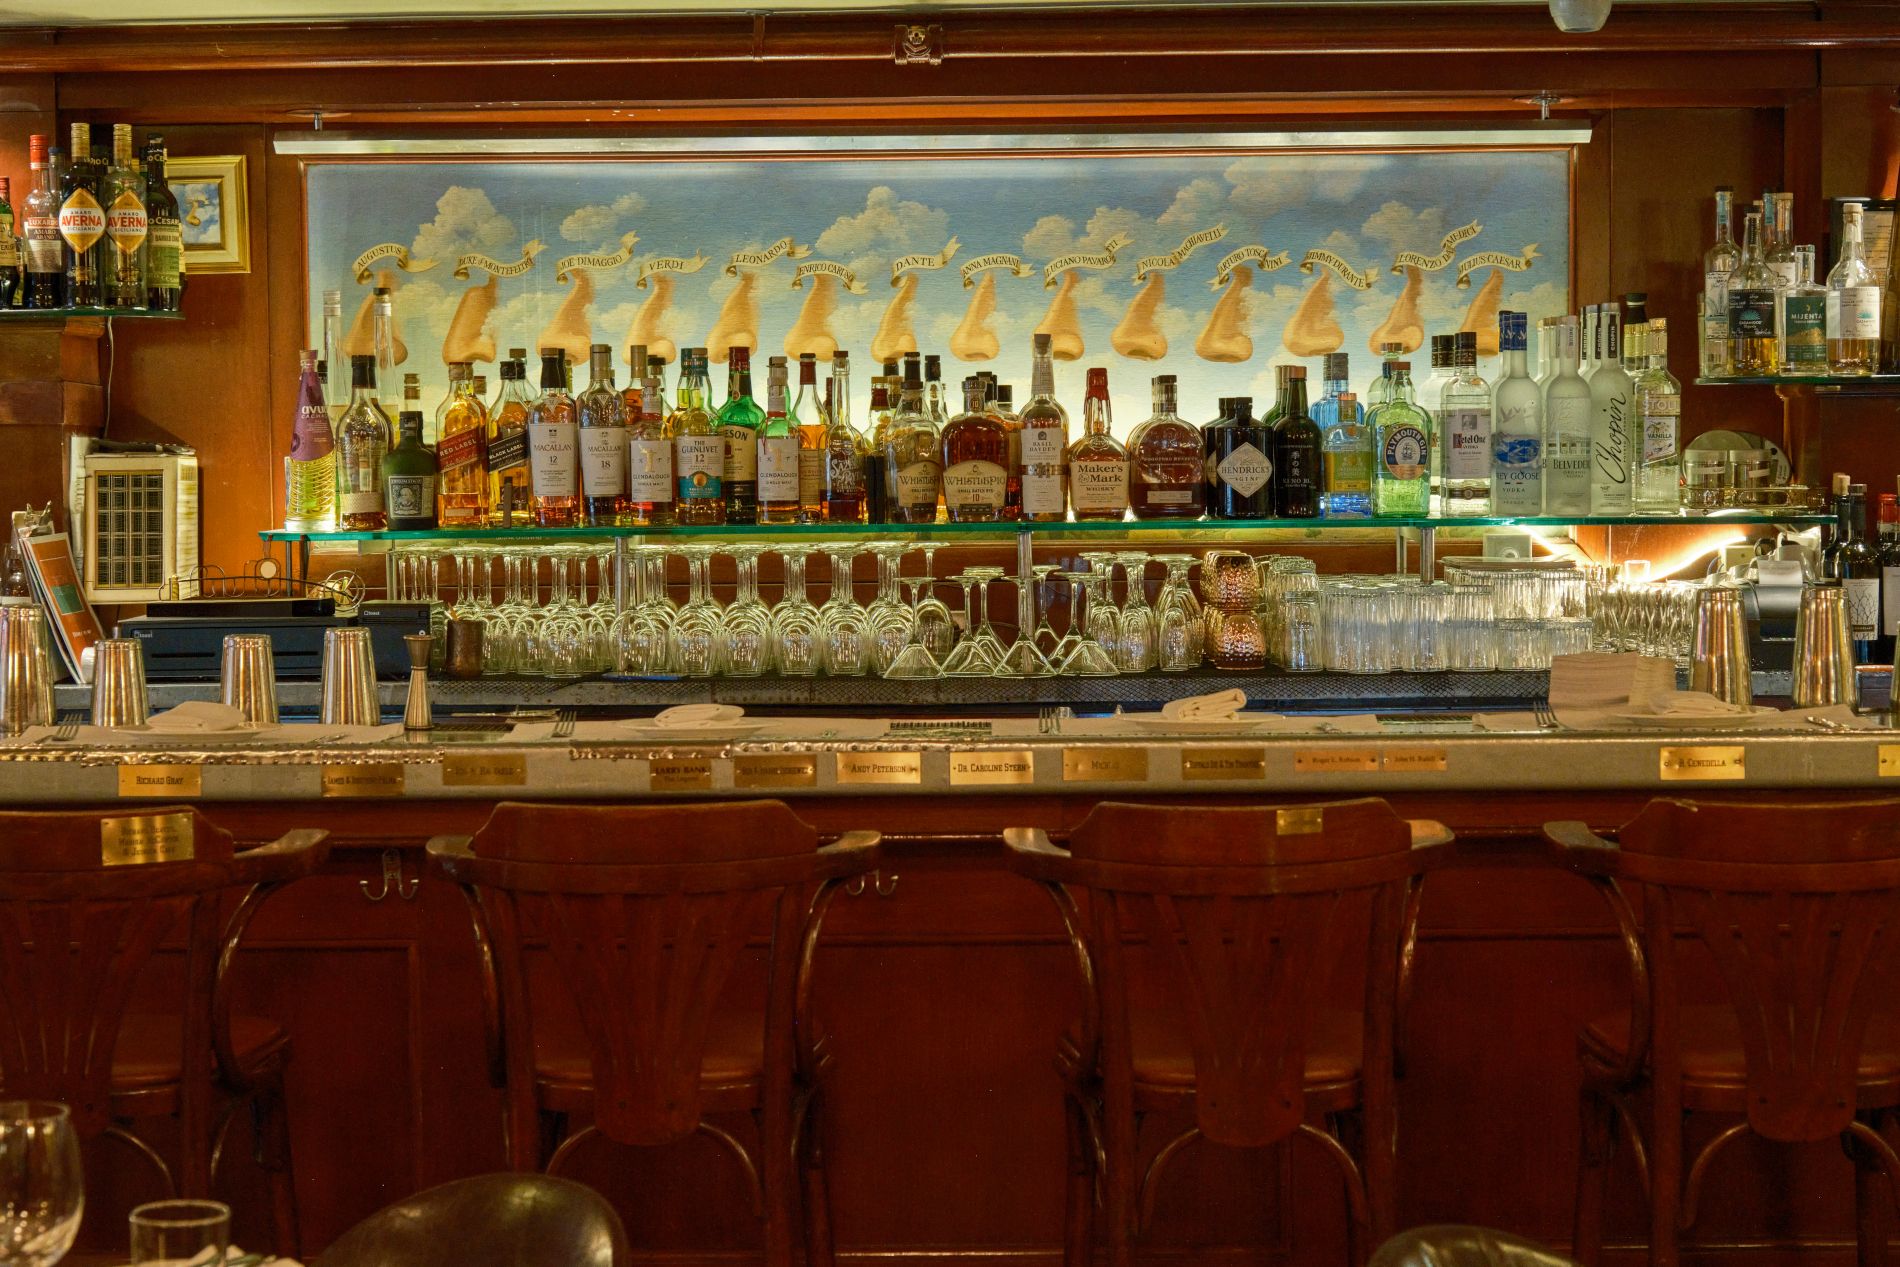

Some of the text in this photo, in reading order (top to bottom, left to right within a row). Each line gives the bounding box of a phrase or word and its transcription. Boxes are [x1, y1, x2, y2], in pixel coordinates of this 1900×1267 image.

[61, 215, 102, 227] AVERNA
[108, 217, 146, 228] AVERNA
[156, 217, 179, 225] CESAR
[735, 240, 788, 264] LEONARDO
[1142, 228, 1222, 270] NICOLA MACHIAVELLI
[1400, 253, 1442, 269] LORENZO
[1446, 226, 1476, 244] MEDICI
[357, 244, 402, 269] AUGUSTUS
[577, 254, 623, 267] DIMAGGIO
[1219, 252, 1245, 273] ARTURO
[1488, 254, 1521, 269] CAESAR
[648, 261, 684, 271] VERDI
[896, 257, 935, 271] DANTE
[962, 256, 1020, 276] ANNA MAGNANI
[1046, 257, 1080, 276] LUCIANO
[1307, 251, 1364, 287] JIMMY DURANTE
[798, 263, 854, 282] ENRICO CARUSO
[725, 429, 748, 441] ESON
[1473, 434, 1486, 444] One
[1595, 392, 1630, 484] Chopin
[439, 438, 477, 457] RED LABEL
[506, 443, 524, 453] LABEL
[1387, 429, 1421, 455] PLYMOUTH
[601, 460, 611, 468] 18
[695, 454, 705, 462] 12
[1078, 464, 1123, 473] Maker's
[1090, 474, 1122, 483] Mark
[972, 494, 980, 502] 10
[851, 763, 906, 773] ANDY PETERSON
[970, 763, 1003, 773] CAROLINE
[1004, 763, 1026, 772] STERN
[136, 776, 184, 785] RICHARD GRAY
